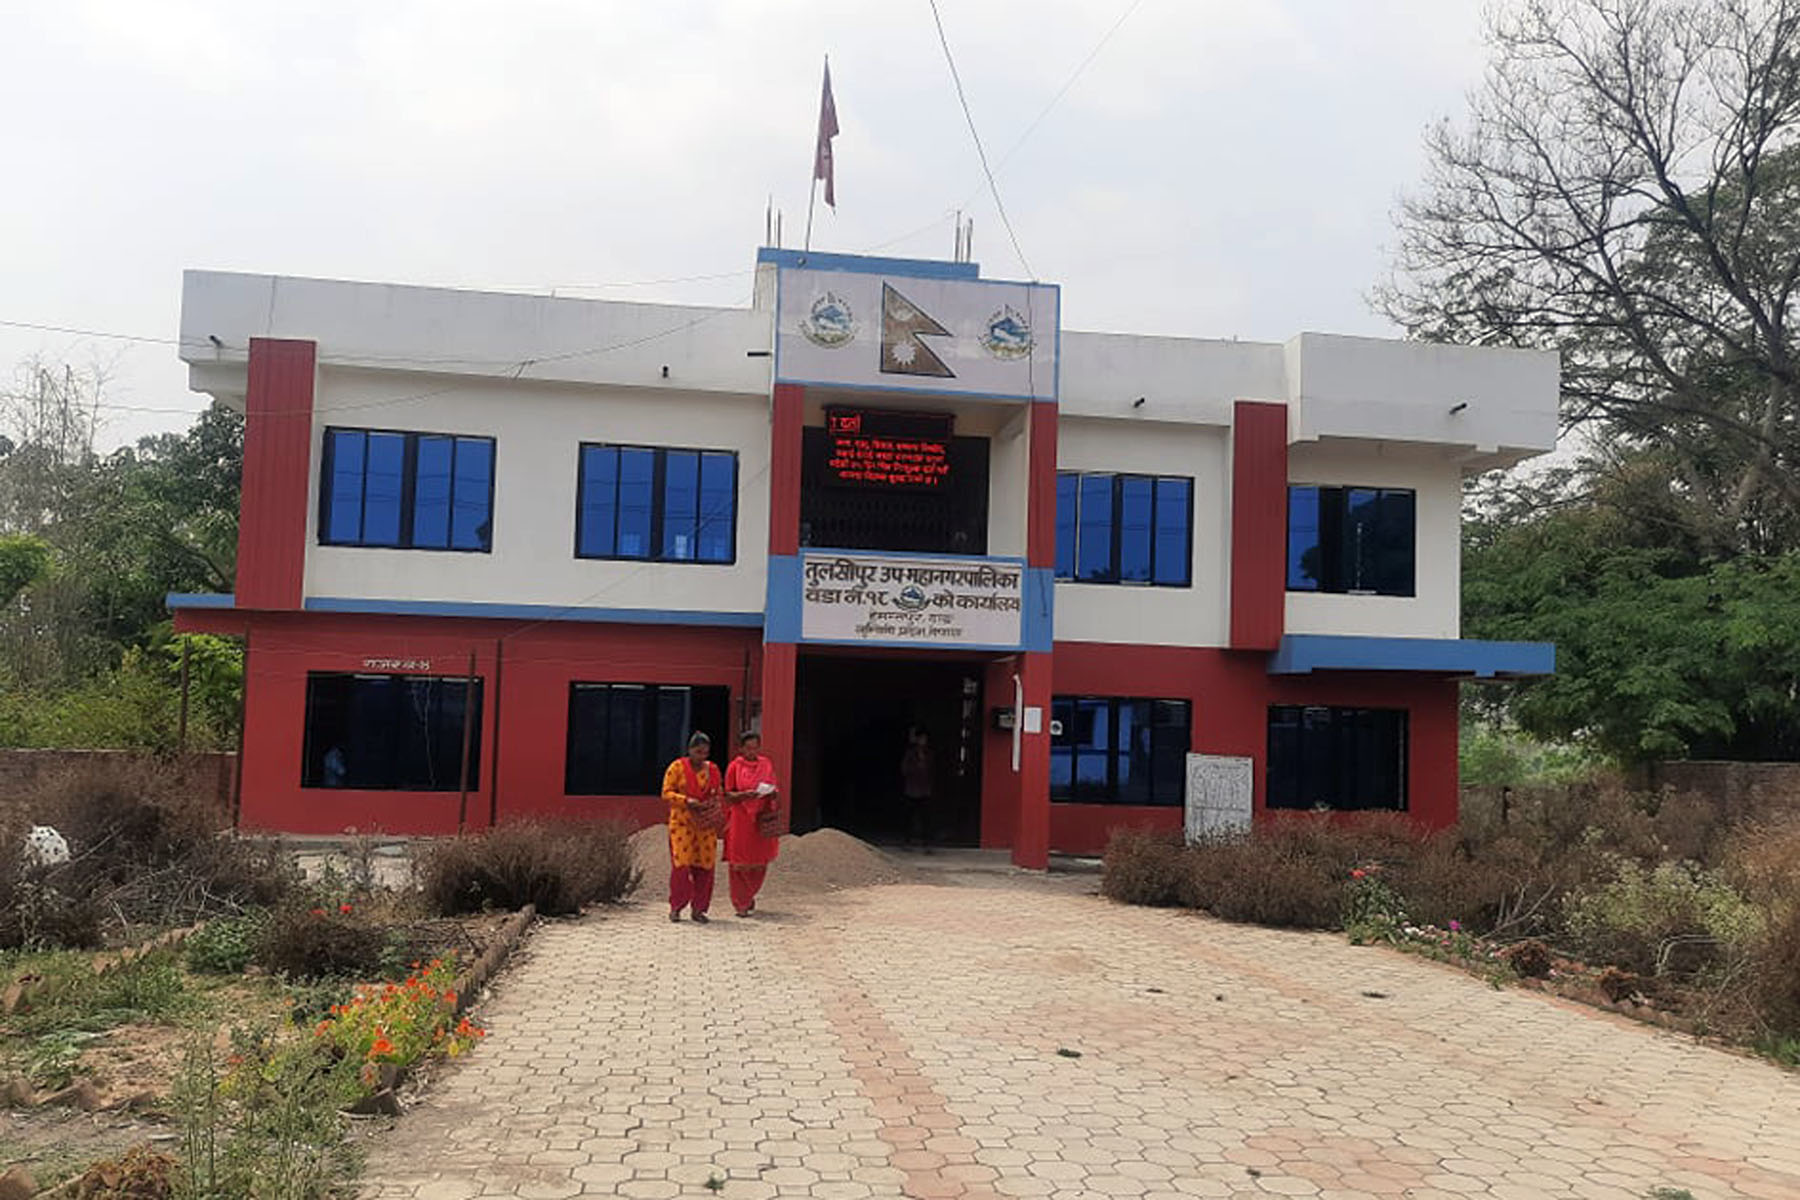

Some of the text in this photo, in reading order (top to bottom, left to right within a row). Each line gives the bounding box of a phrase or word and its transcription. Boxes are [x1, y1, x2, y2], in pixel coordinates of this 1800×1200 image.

[806, 559, 878, 588] तुलसीपुर
[806, 587, 842, 604] वडा
[956, 591, 1020, 612] कार्यालय
